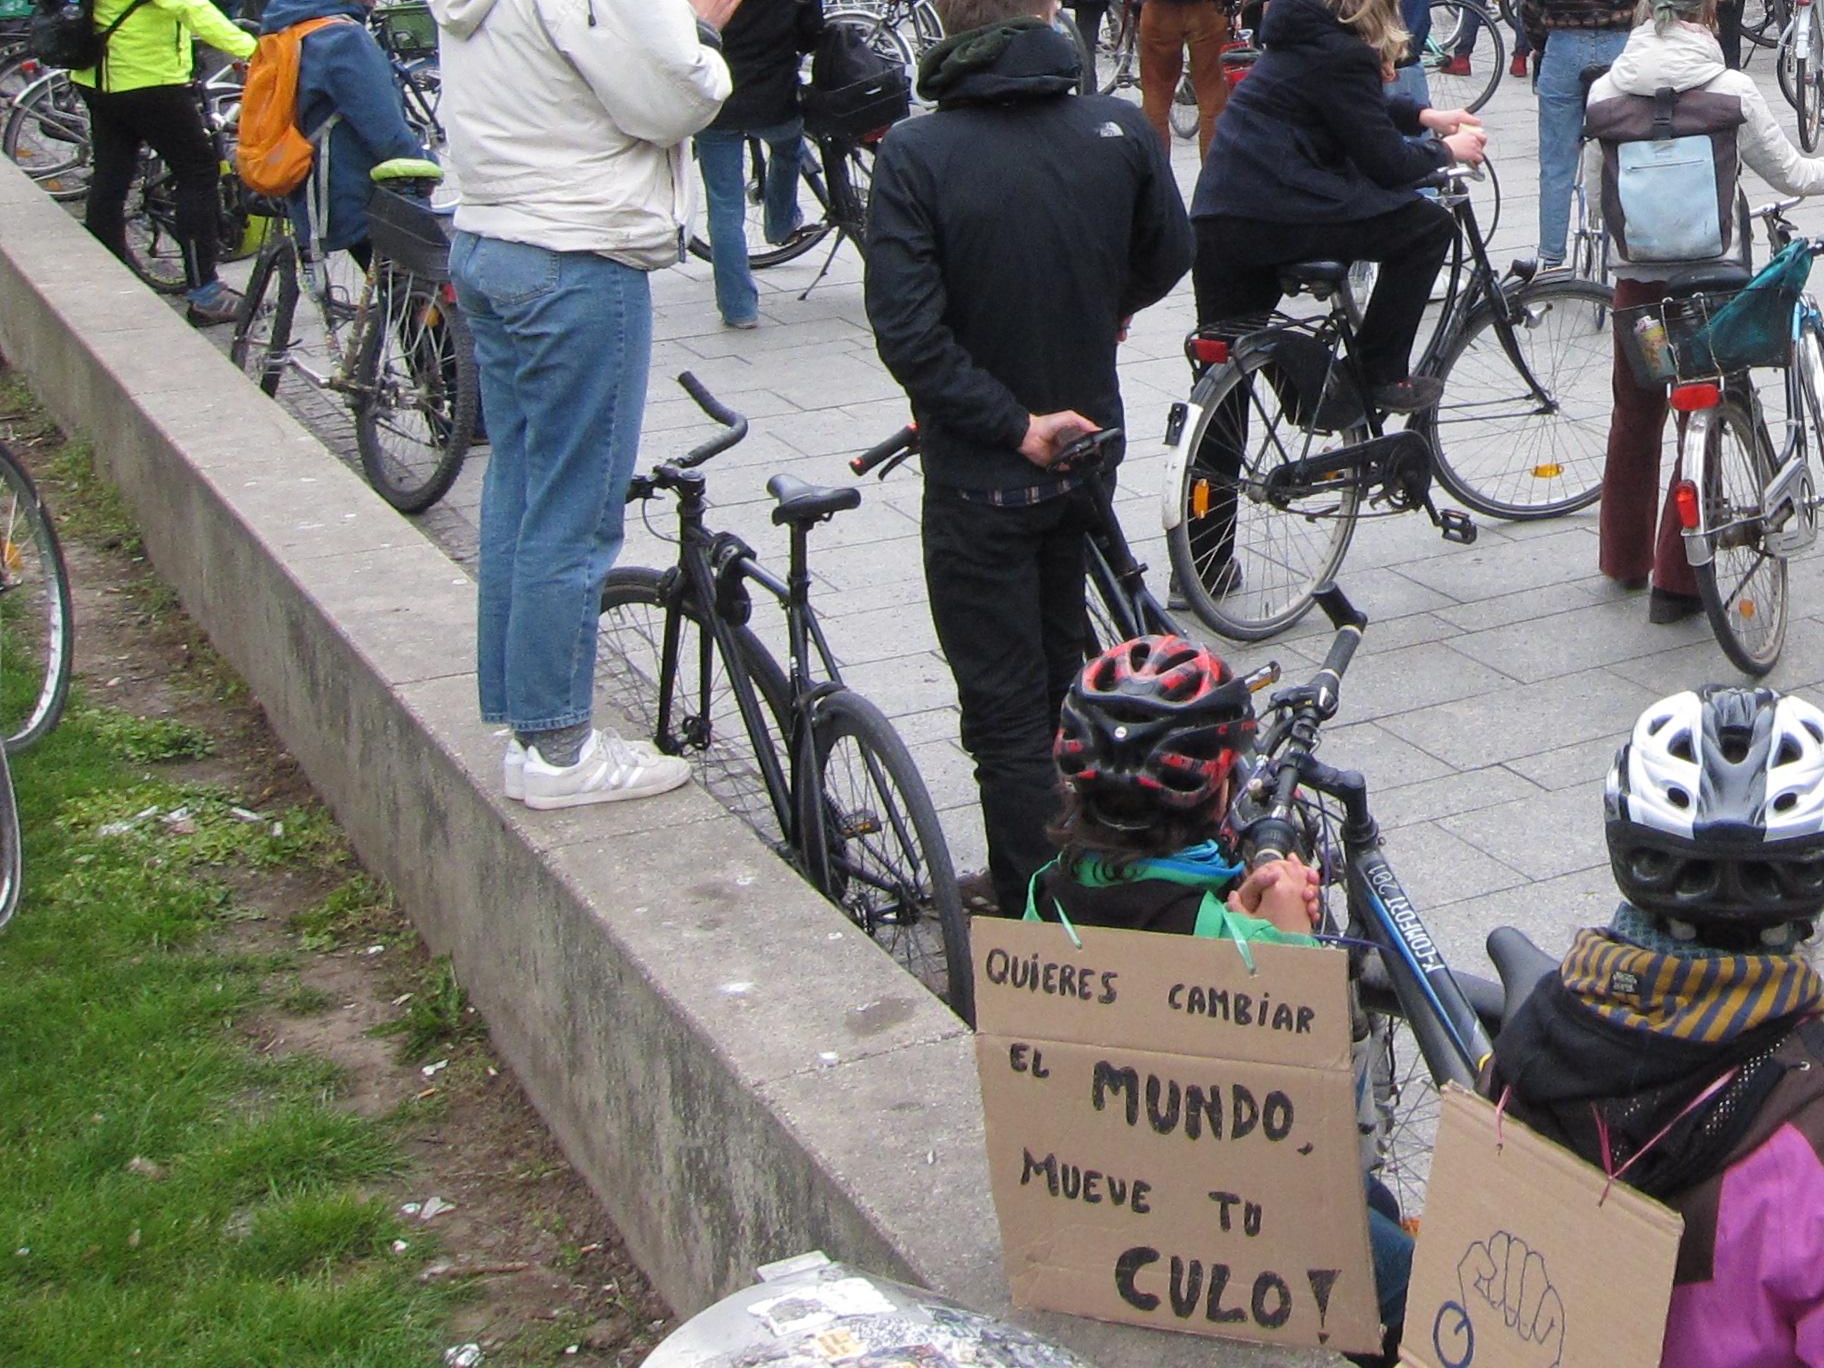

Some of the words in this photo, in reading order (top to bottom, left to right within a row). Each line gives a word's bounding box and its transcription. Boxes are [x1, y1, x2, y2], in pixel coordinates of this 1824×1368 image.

[986, 948, 1119, 1004] QUIERES
[1168, 983, 1316, 1034] CAMBIAR
[1010, 1044, 1049, 1078] EL
[1020, 1148, 1152, 1214] MUEVE
[1208, 1191, 1263, 1236] TU
[1114, 1246, 1342, 1345] CULO!
